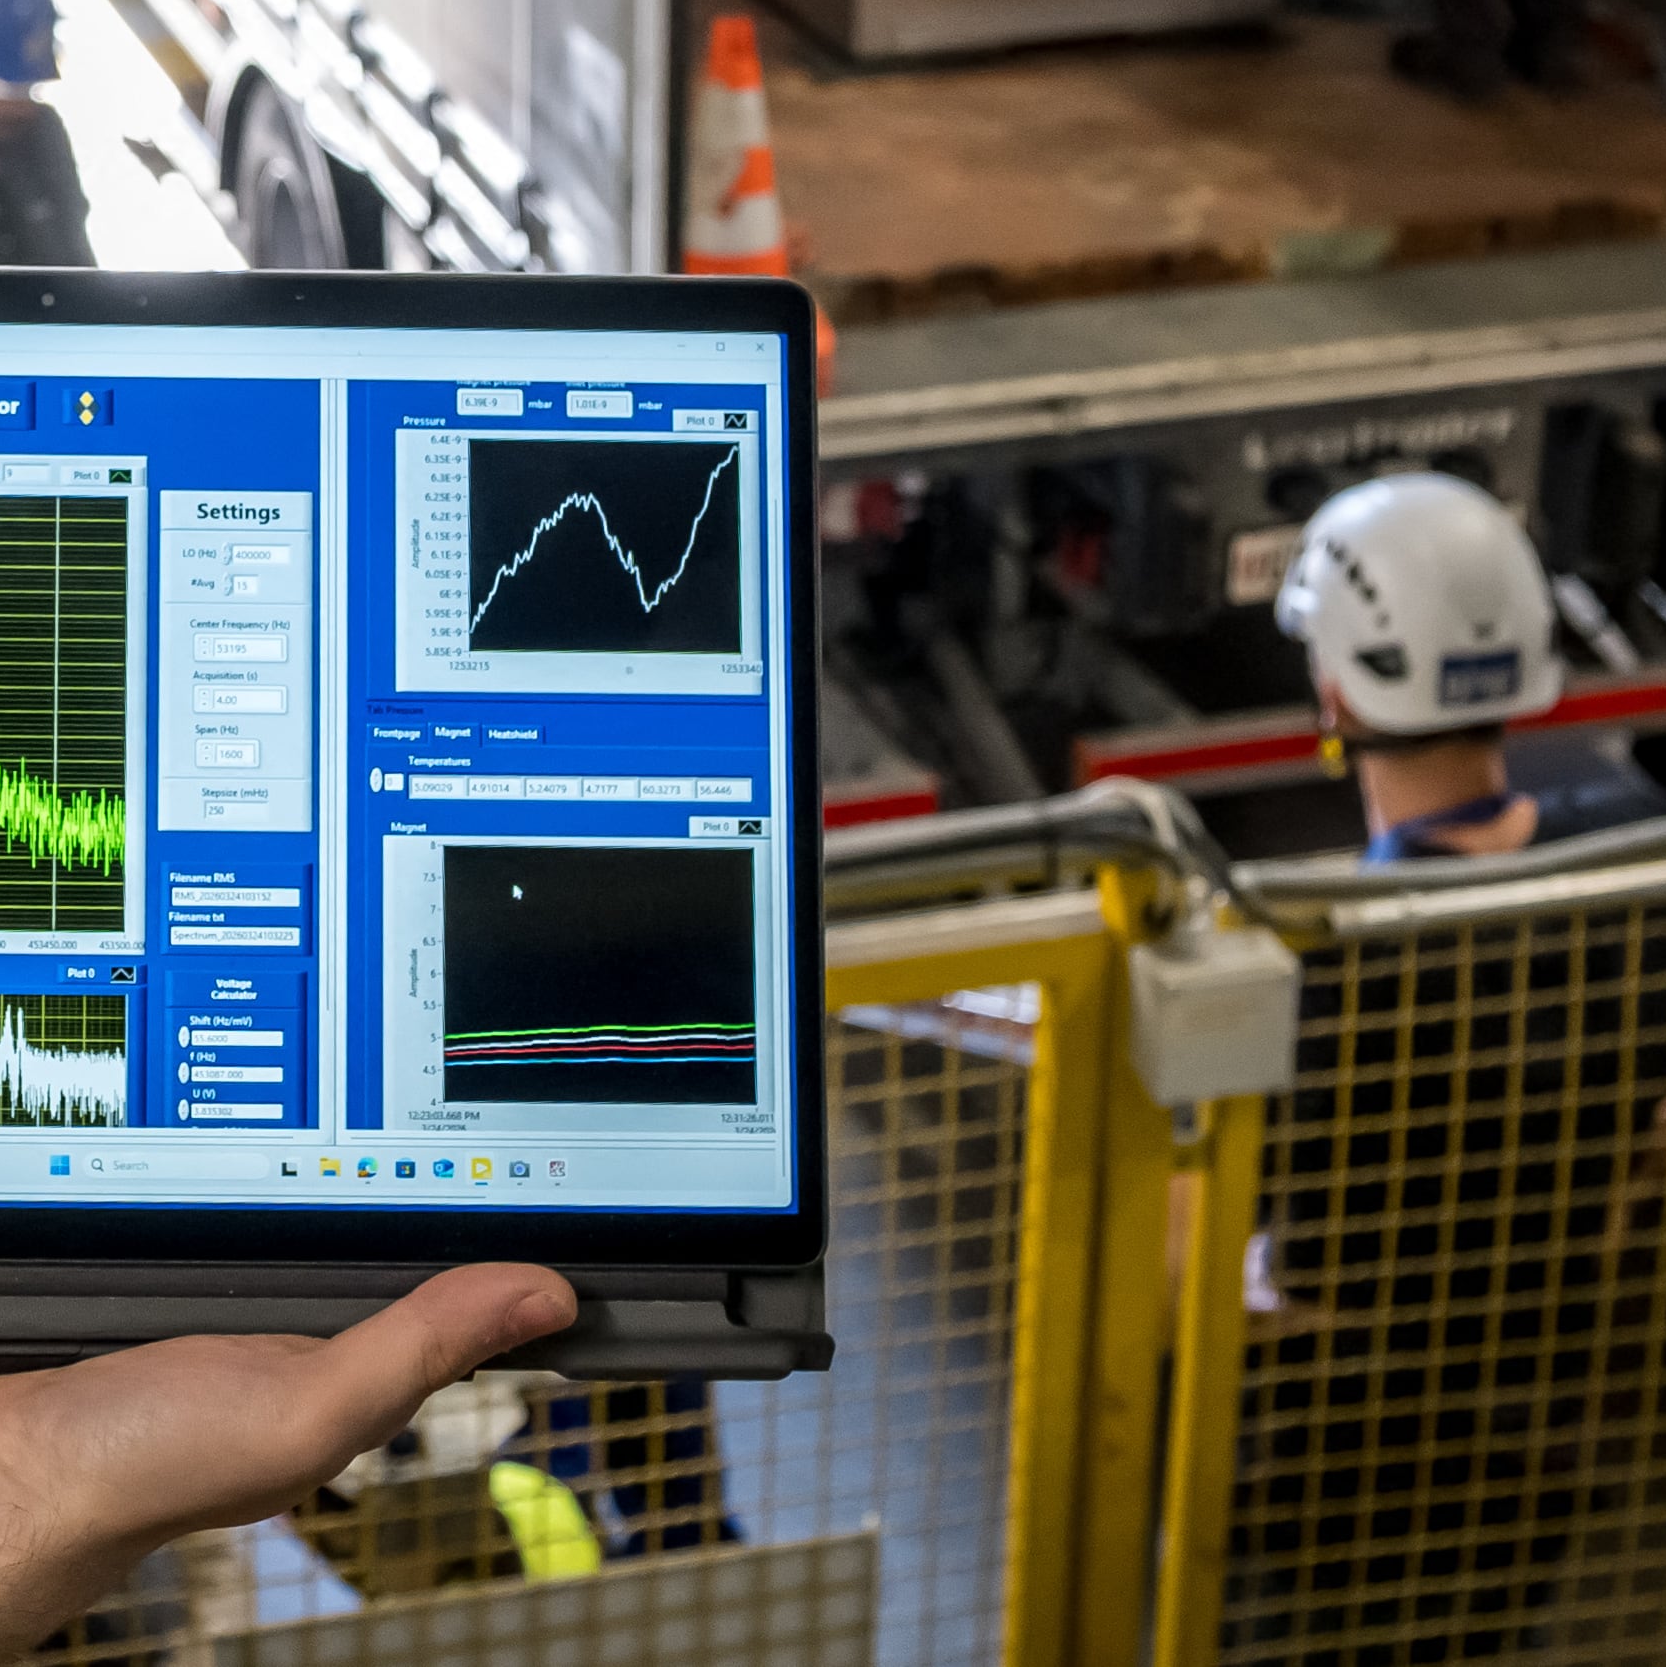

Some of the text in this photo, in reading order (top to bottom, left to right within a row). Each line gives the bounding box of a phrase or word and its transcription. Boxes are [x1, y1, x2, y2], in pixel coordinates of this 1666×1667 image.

[528, 399, 552, 409] mbar
[638, 401, 663, 410] mbar
[403, 416, 445, 426] Pressure
[687, 417, 704, 425] Plot
[431, 436, 461, 444] 6.4E-9
[425, 455, 461, 463] 6.35E-9
[74, 471, 92, 479] Plot
[431, 474, 461, 482] 6.3E-9
[425, 493, 461, 501] 6.25E-9
[197, 503, 280, 524] Settings
[431, 513, 461, 521] 6.2E-9
[425, 532, 461, 540] 6.15E-9
[411, 519, 421, 568] Amplitude
[198, 549, 216, 559] (Hz)
[236, 551, 271, 559] 400000
[431, 551, 461, 559] 6.1E-9
[191, 579, 215, 590] #Avg
[238, 582, 247, 590] 15
[190, 620, 290, 630] Center Frequency (Hz)
[217, 645, 246, 653] 53195
[449, 662, 489, 670] 1253215
[193, 672, 257, 681] Acquisition (s)
[217, 696, 237, 704] 4.00
[196, 725, 239, 735] Span (Hz)
[374, 728, 421, 740] Frontpage
[435, 727, 471, 739] Magnet
[489, 730, 537, 739] Heatshield
[220, 751, 242, 759] 1600
[408, 756, 471, 767] Temperatures
[472, 784, 509, 792] 4.91014
[586, 785, 617, 794] 4.7177
[202, 789, 268, 798] Stepsize (mHz)
[208, 806, 224, 815] 250
[391, 822, 426, 834] Magnet
[704, 822, 720, 830] Plot
[170, 873, 235, 883] Filename RMS
[423, 873, 435, 882] 7.5
[169, 912, 224, 922] Filename txt
[68, 968, 87, 978] Plot
[409, 948, 420, 998] Amplitude
[216, 979, 252, 990] Voltage
[211, 991, 257, 1000] Calculator
[423, 1000, 436, 1010] 5.5
[190, 1016, 252, 1027] Shift (Hz/mV)
[197, 1053, 216, 1062] (Hz)
[423, 1066, 436, 1074] 4.5
[193, 1089, 215, 1099] U (V)
[113, 1161, 148, 1170] Search
